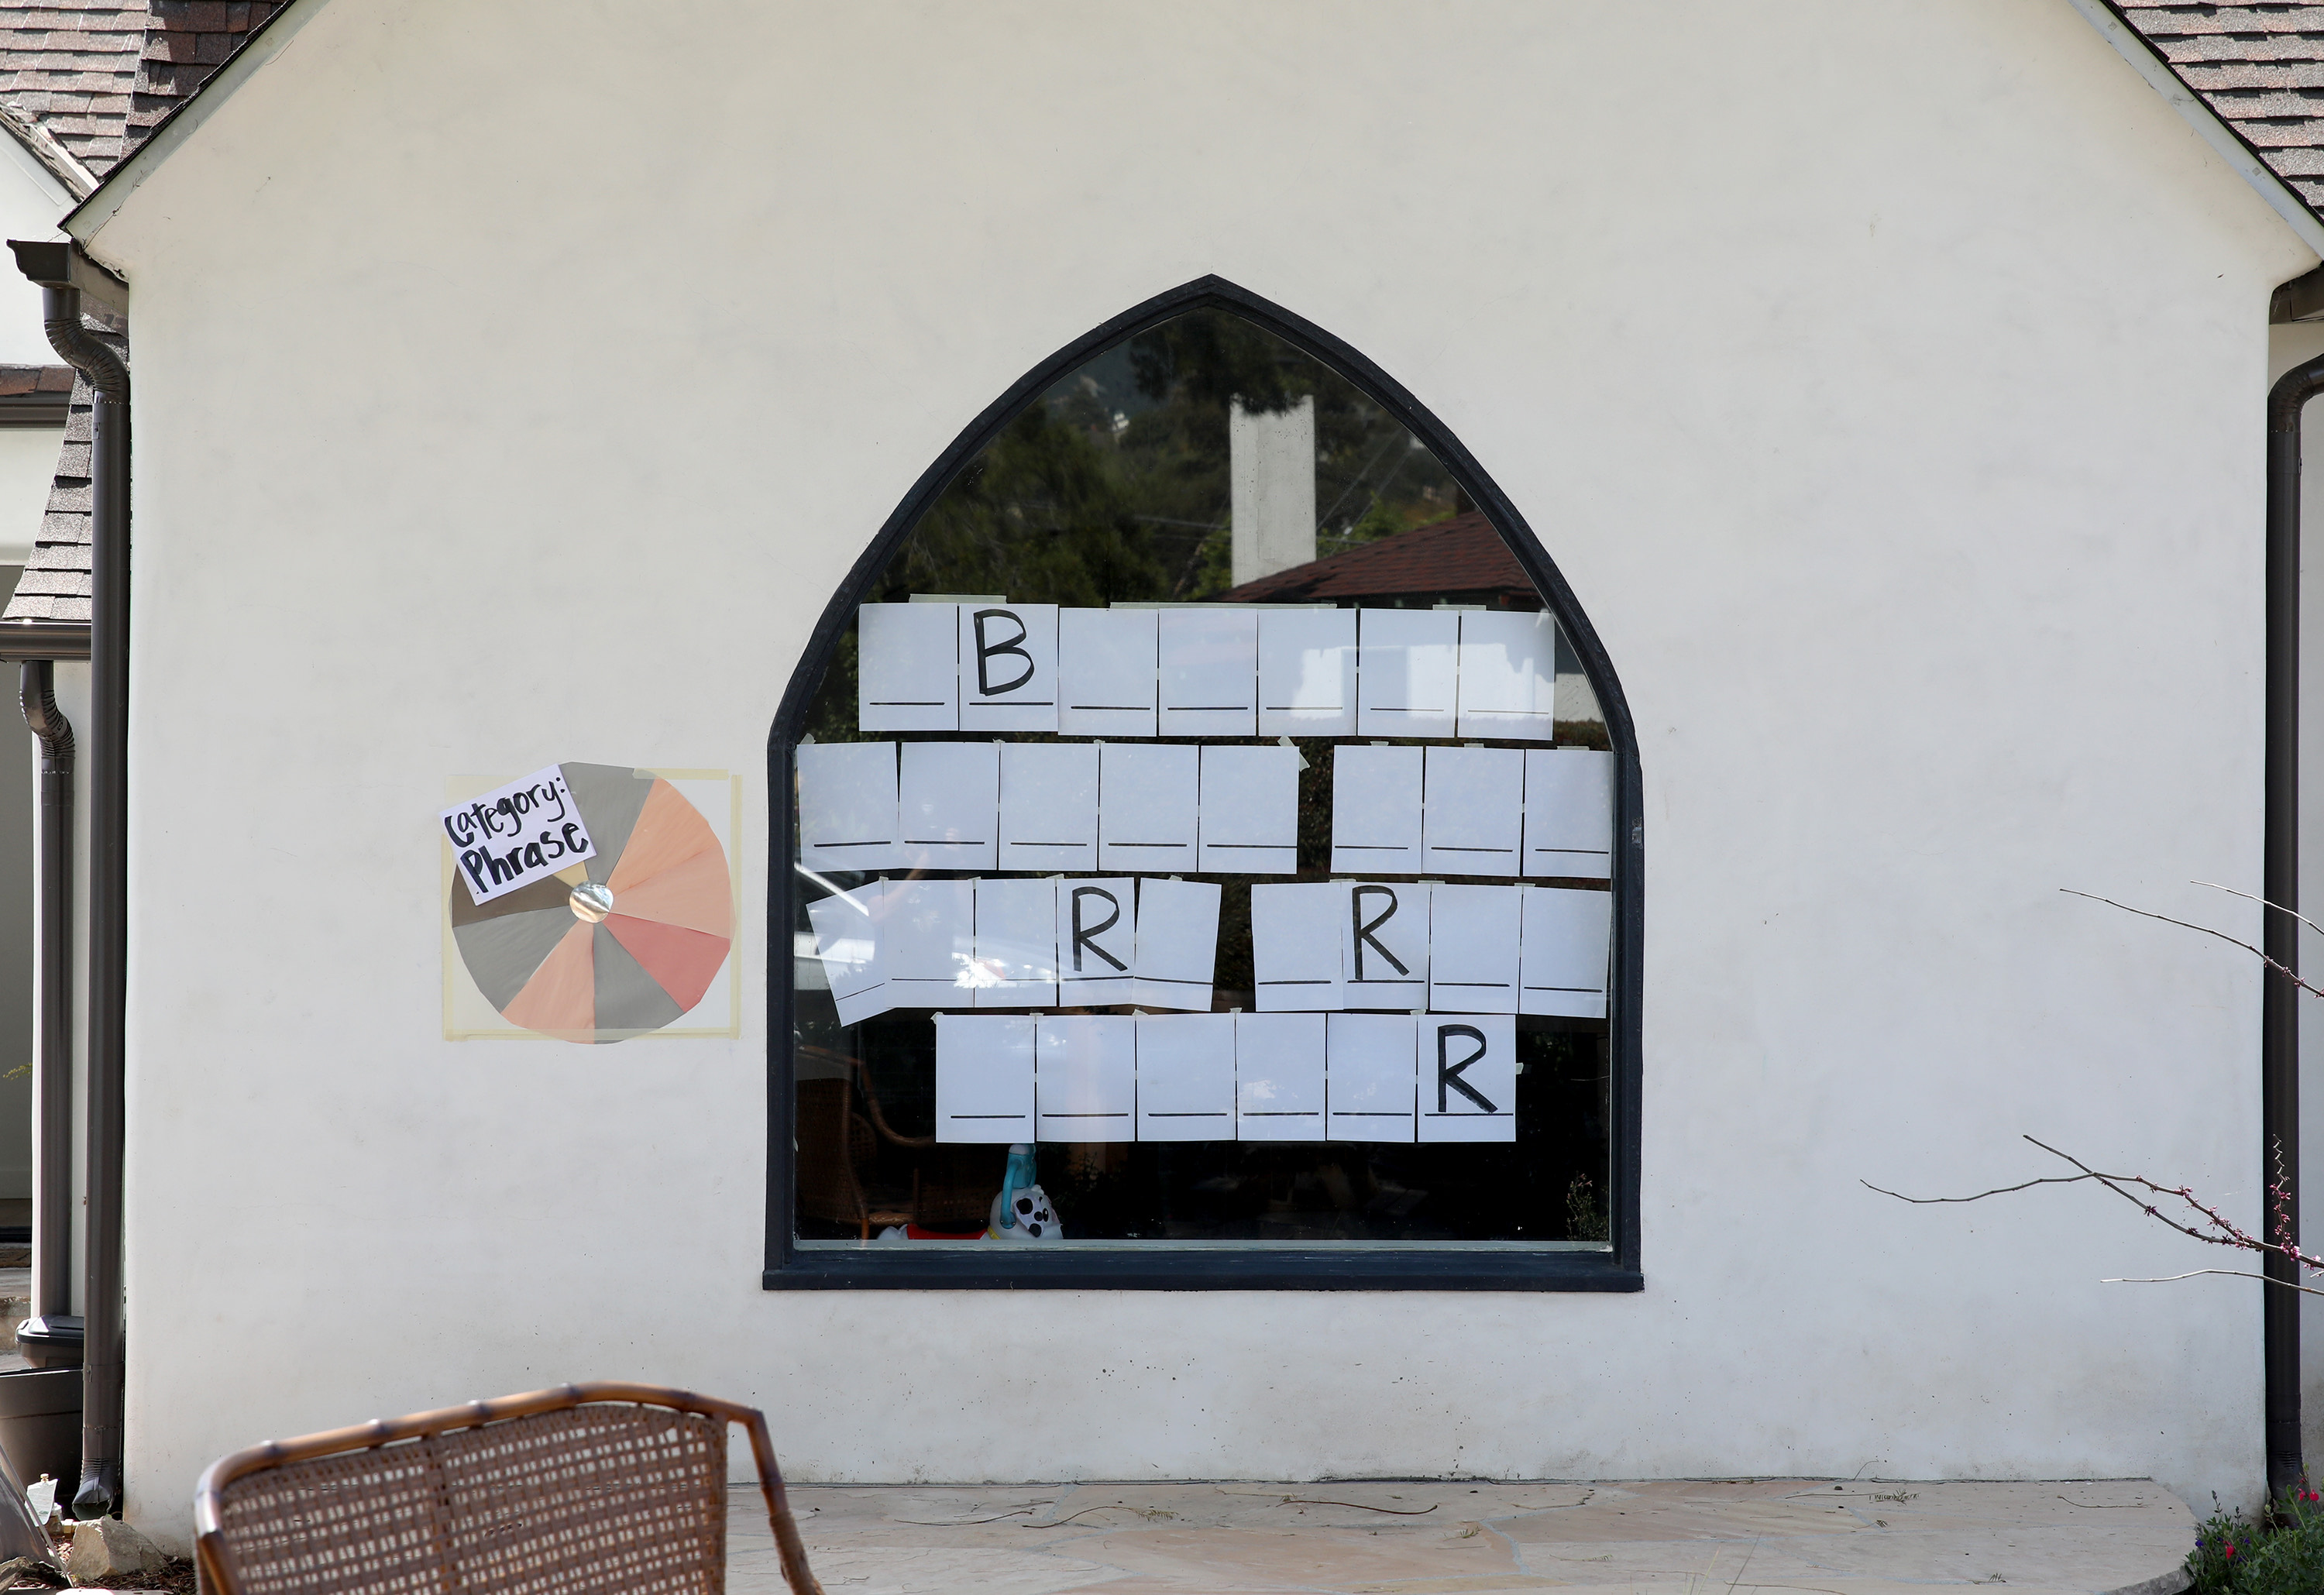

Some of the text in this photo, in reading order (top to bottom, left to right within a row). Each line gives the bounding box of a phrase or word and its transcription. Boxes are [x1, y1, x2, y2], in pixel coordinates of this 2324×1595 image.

[973, 609, 1035, 696] B
[445, 777, 566, 847] Category:
[460, 822, 589, 894] Phrase
[1072, 885, 1410, 980] R R
[1437, 1024, 1498, 1114] R
